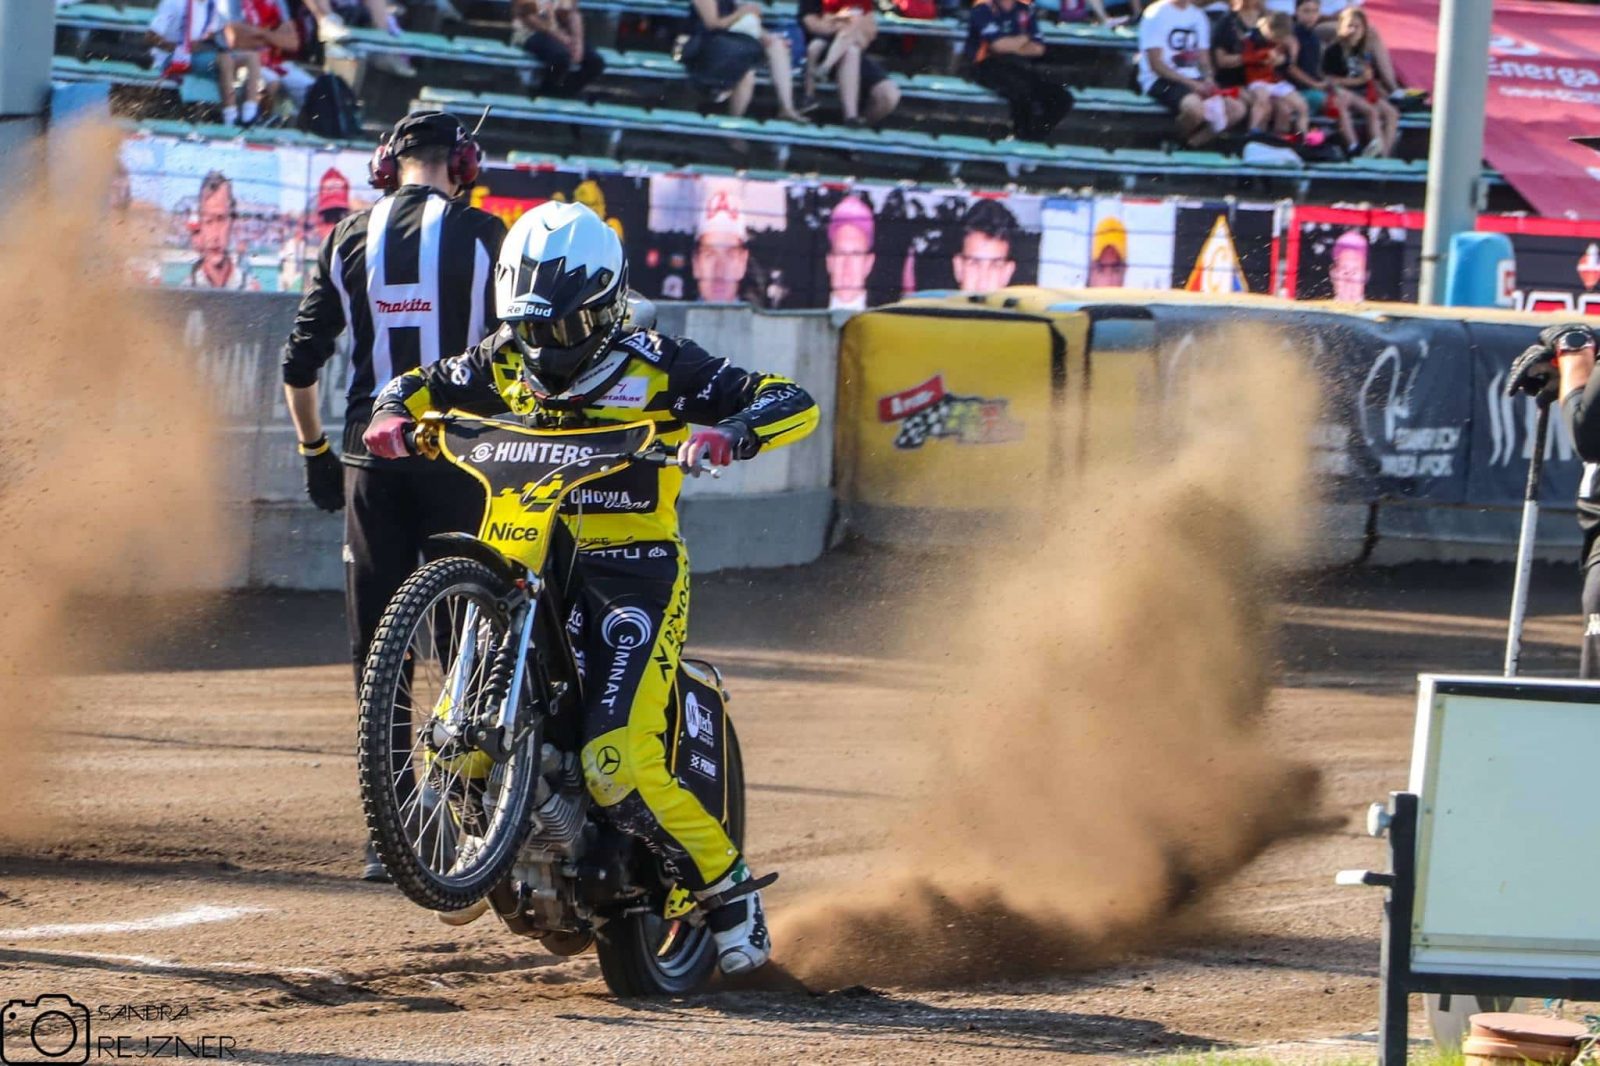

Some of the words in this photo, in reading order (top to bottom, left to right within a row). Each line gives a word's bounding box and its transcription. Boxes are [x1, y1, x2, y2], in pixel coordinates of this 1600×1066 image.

[376, 298, 432, 314] makita
[493, 441, 594, 467] HUNTERS
[487, 522, 539, 542] Nice
[600, 633, 634, 709] SIMNAT
